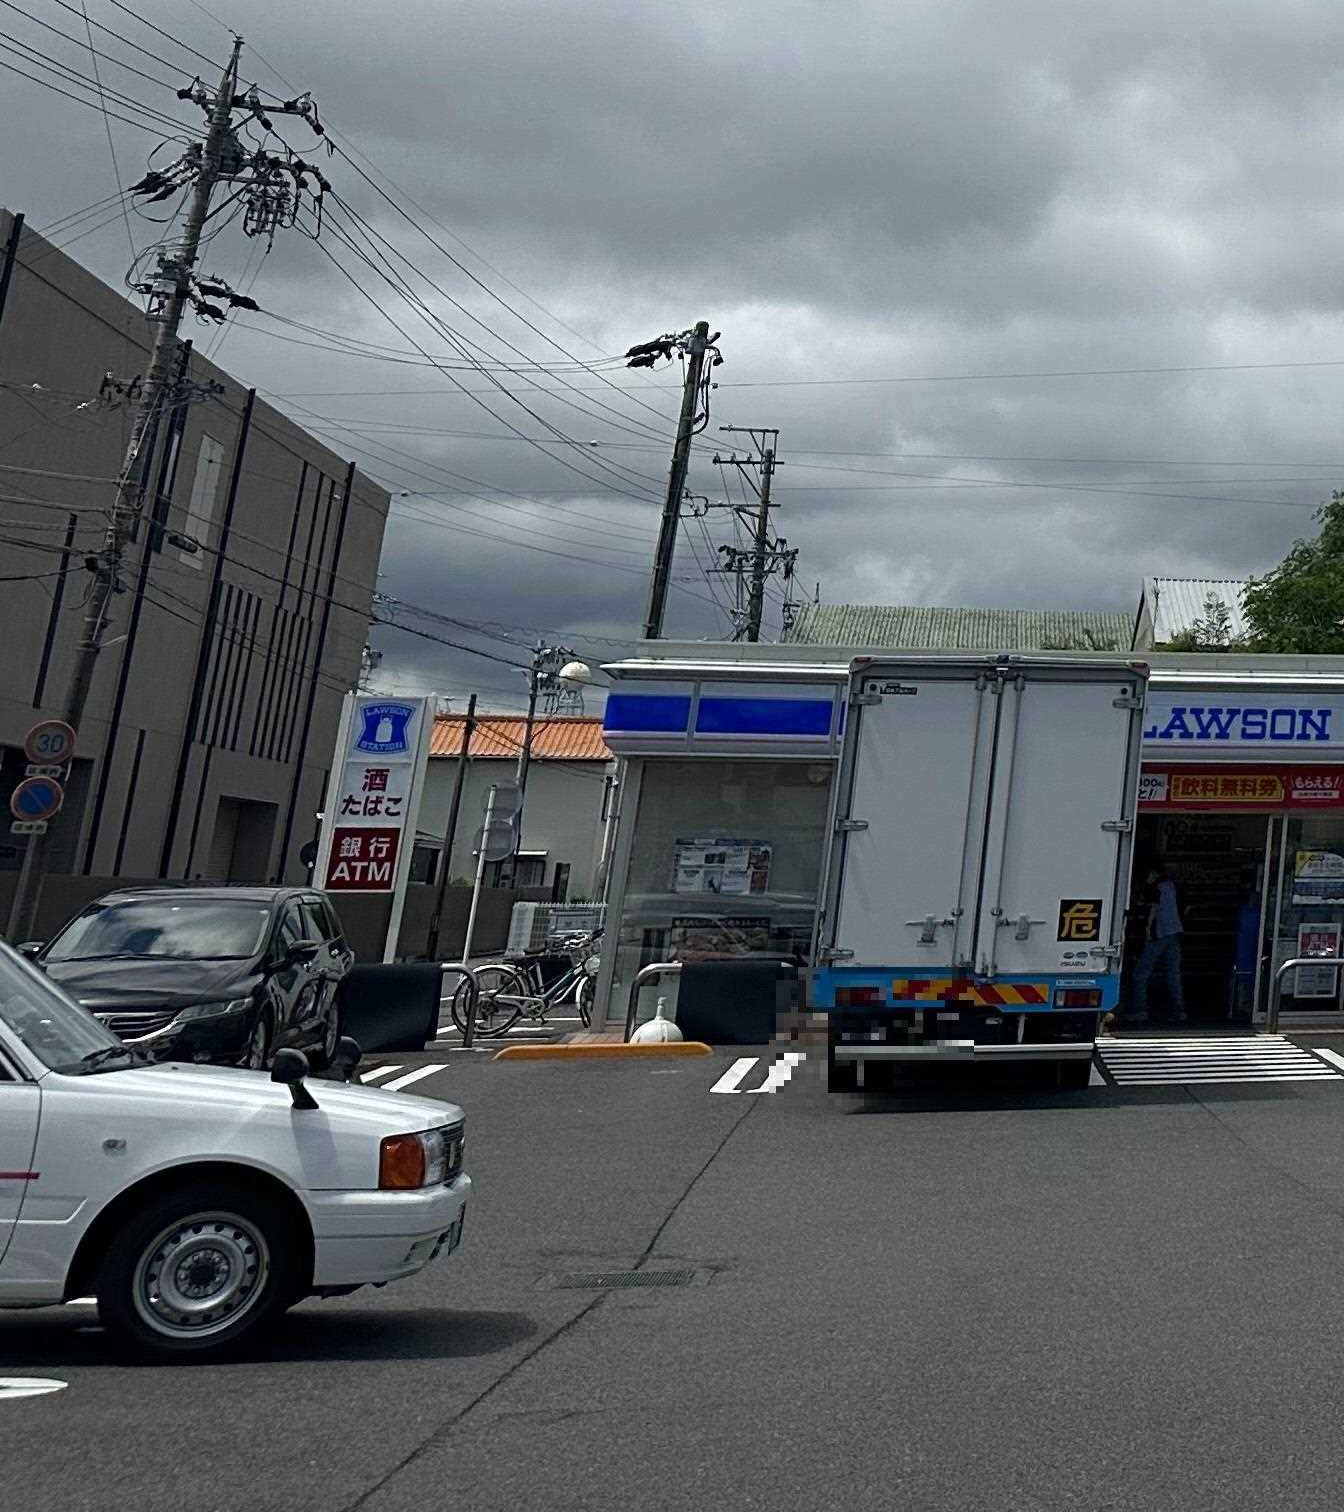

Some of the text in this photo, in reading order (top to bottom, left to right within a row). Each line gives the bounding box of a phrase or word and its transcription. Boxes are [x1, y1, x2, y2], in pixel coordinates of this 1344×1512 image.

[38, 735, 64, 753] 30
[362, 768, 390, 792] 酒
[341, 794, 403, 816] たばこ
[339, 837, 390, 858] 銀行
[331, 862, 390, 881] ATM
[1061, 903, 1098, 939] 危
